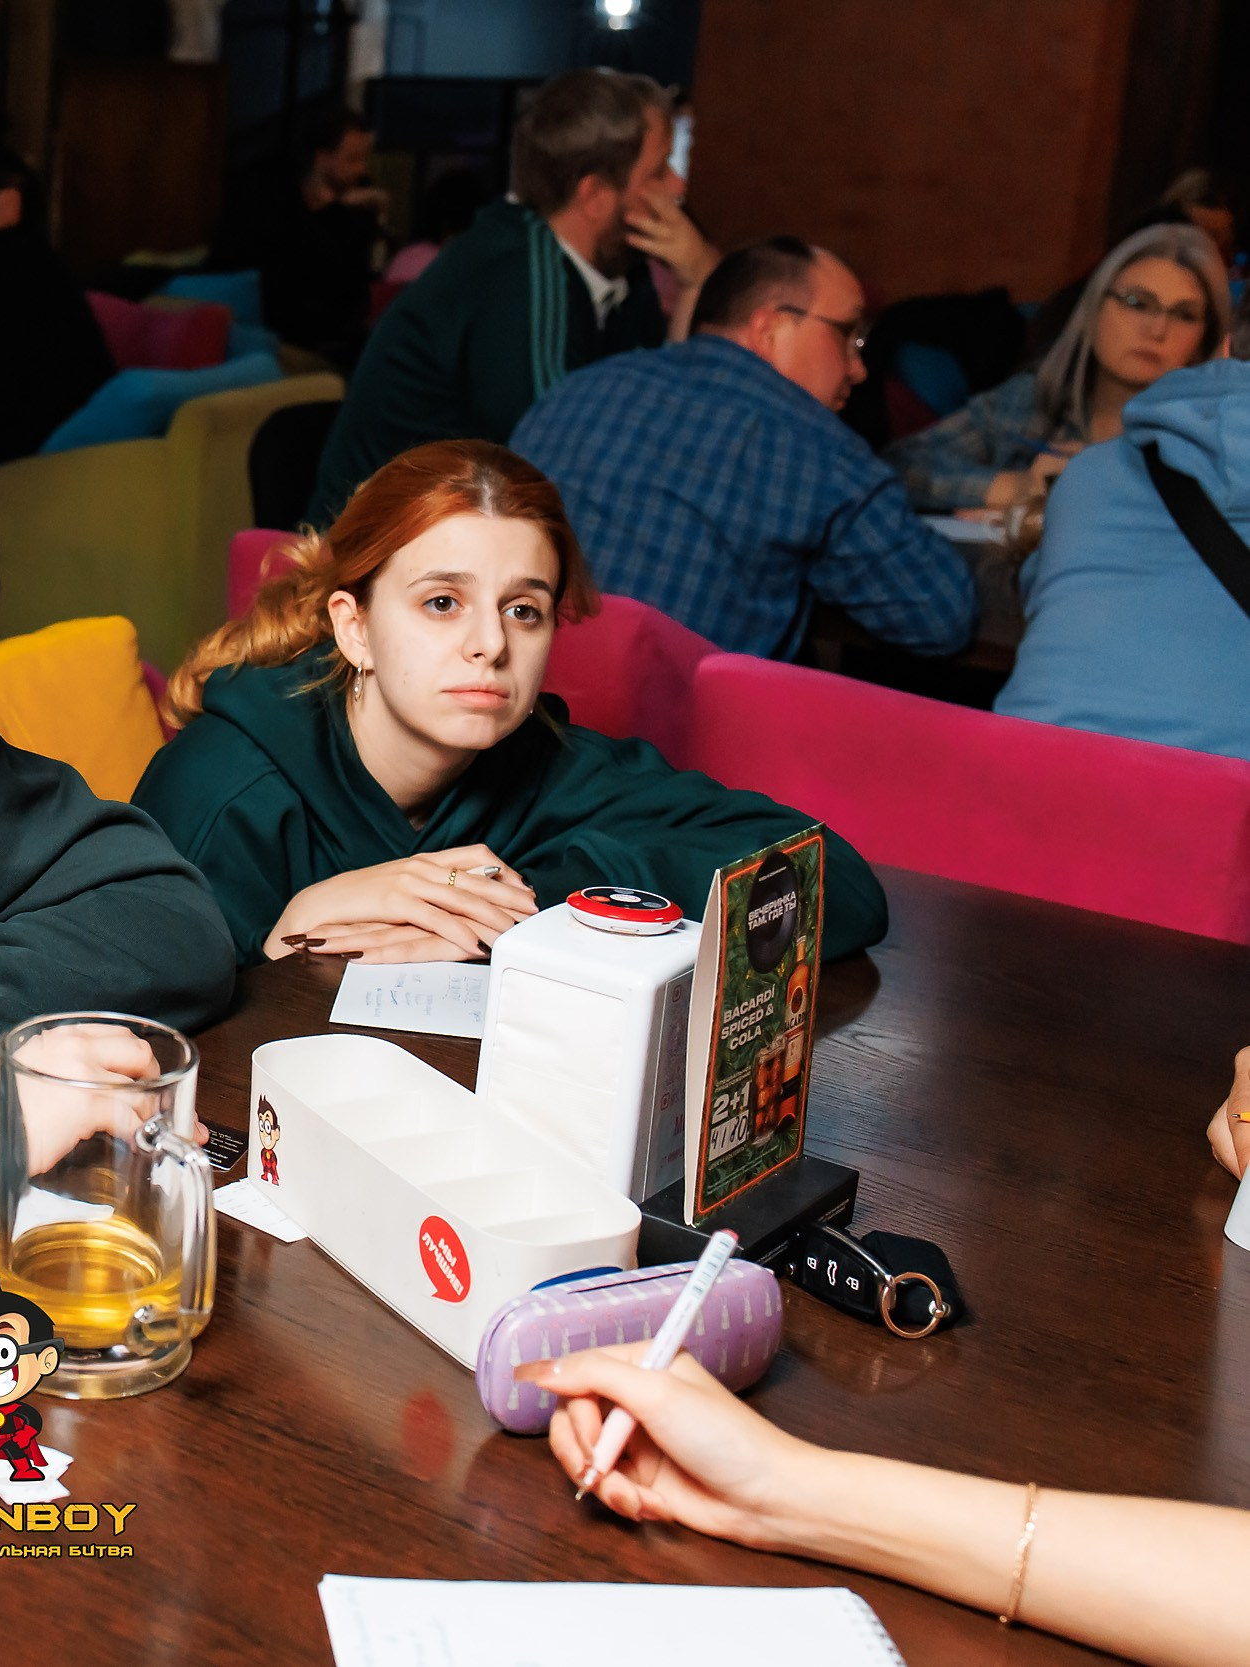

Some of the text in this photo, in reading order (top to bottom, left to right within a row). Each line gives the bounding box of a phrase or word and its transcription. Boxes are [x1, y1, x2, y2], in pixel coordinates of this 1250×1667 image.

[748, 891, 796, 921] ВЕЧЕРИНКА
[768, 906, 784, 921] ГДЕ
[784, 899, 797, 913] ТЫ
[720, 1003, 774, 1040] SPICED &
[729, 1025, 762, 1051] COLA
[711, 1081, 752, 1125] 2+1
[421, 1232, 464, 1296] ЛУЧШИЕ!
[438, 1238, 457, 1267] МЫ
